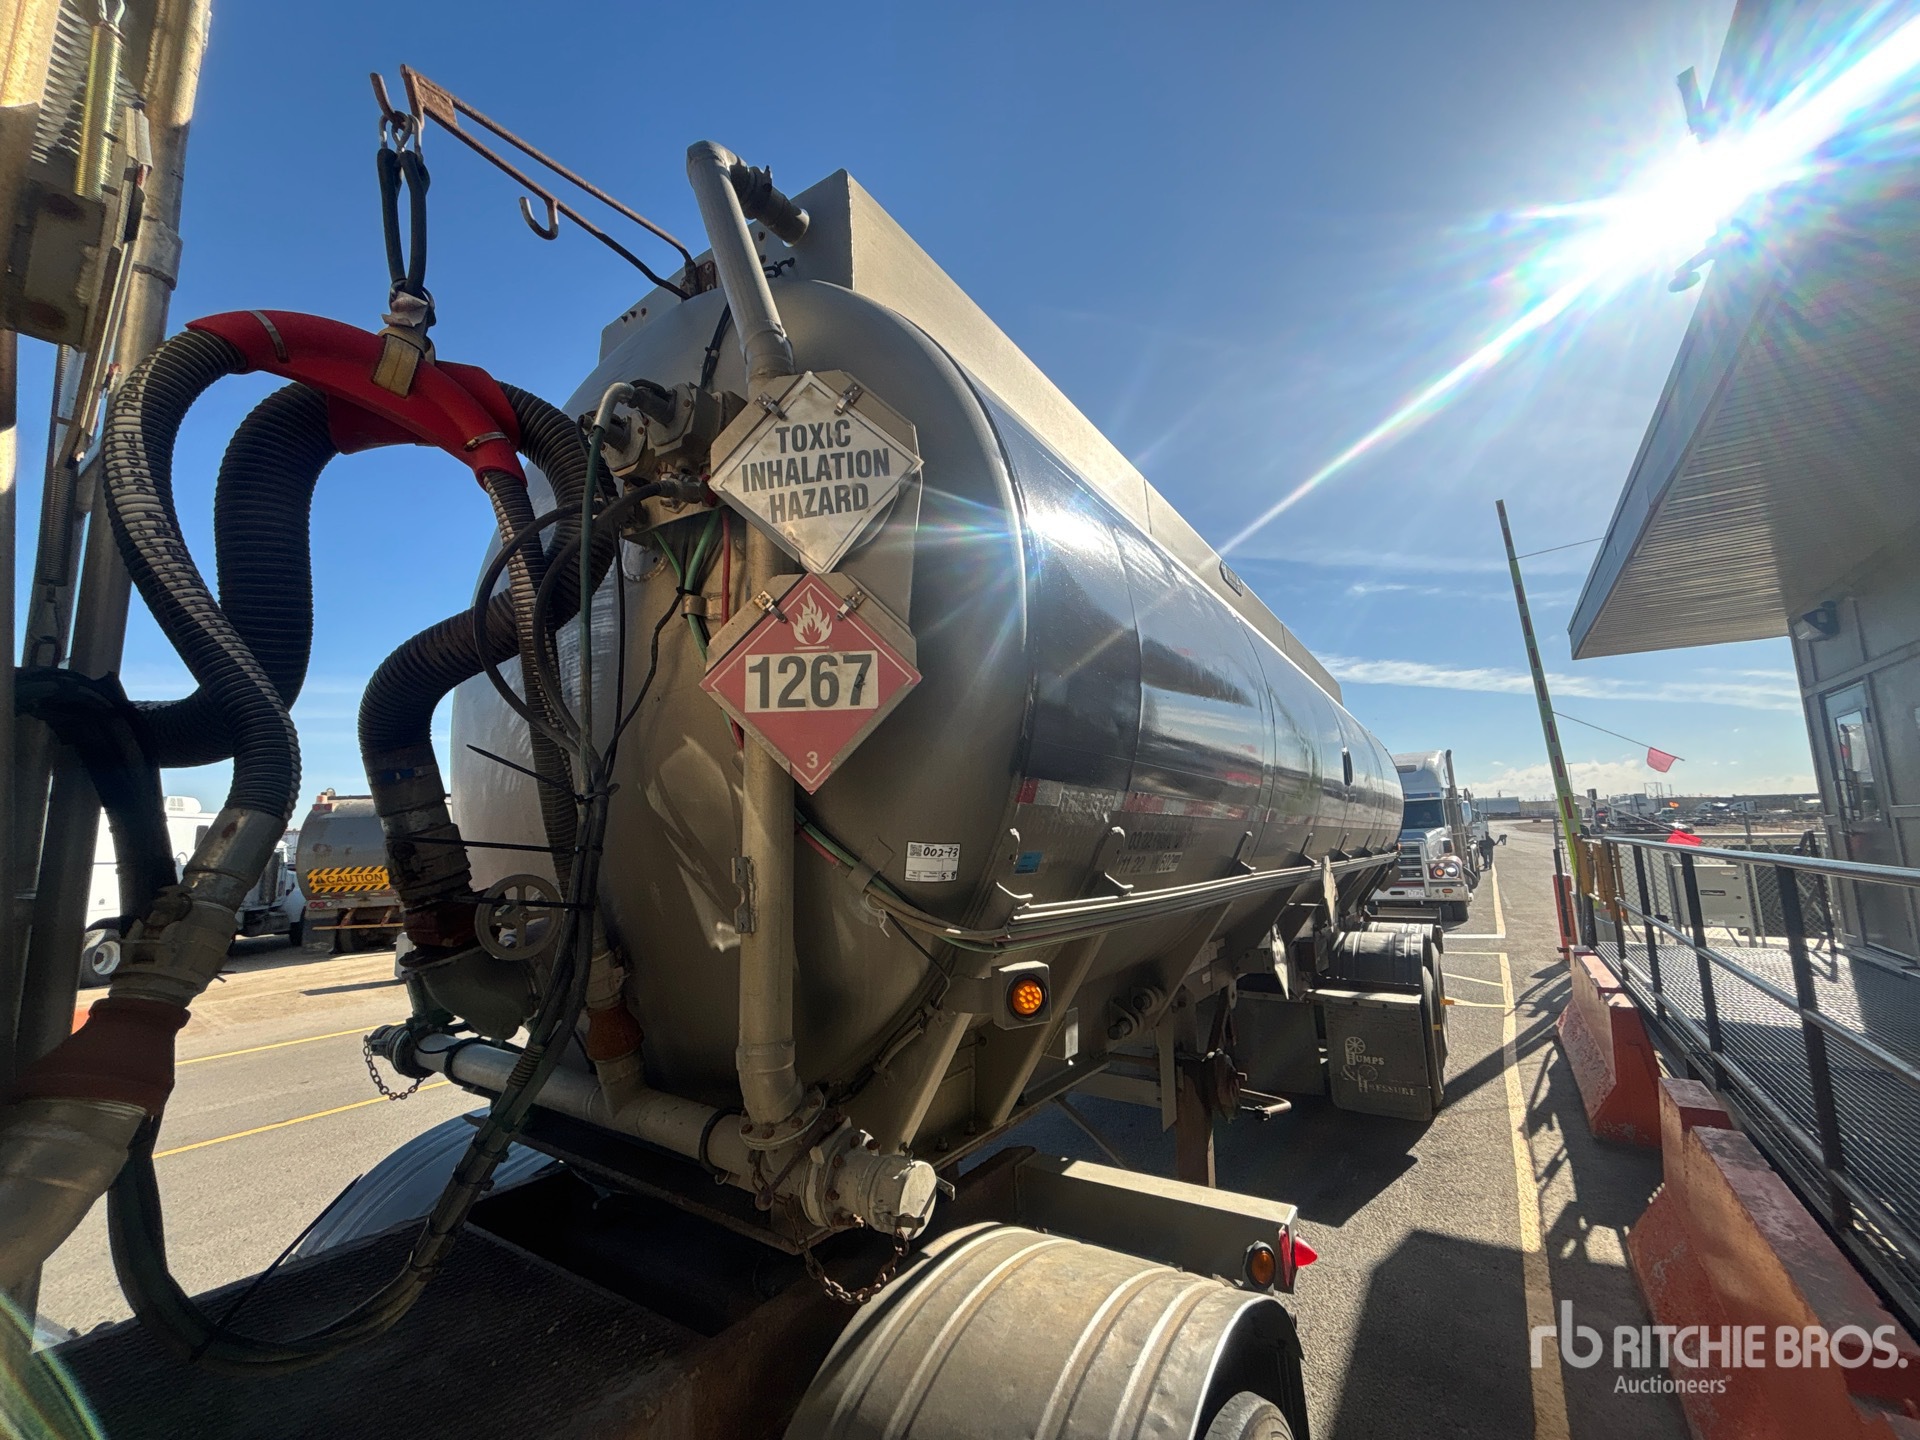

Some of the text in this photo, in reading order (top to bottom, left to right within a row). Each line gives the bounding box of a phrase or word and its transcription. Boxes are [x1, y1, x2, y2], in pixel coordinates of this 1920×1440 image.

[775, 419, 851, 454] TOXIC
[741, 448, 891, 493] INHALATION
[769, 483, 869, 524] HAZARD
[748, 654, 872, 709] 1267
[806, 751, 818, 769] 3
[326, 873, 383, 883] CAUTION
[1344, 1036, 1385, 1066] PUMPS
